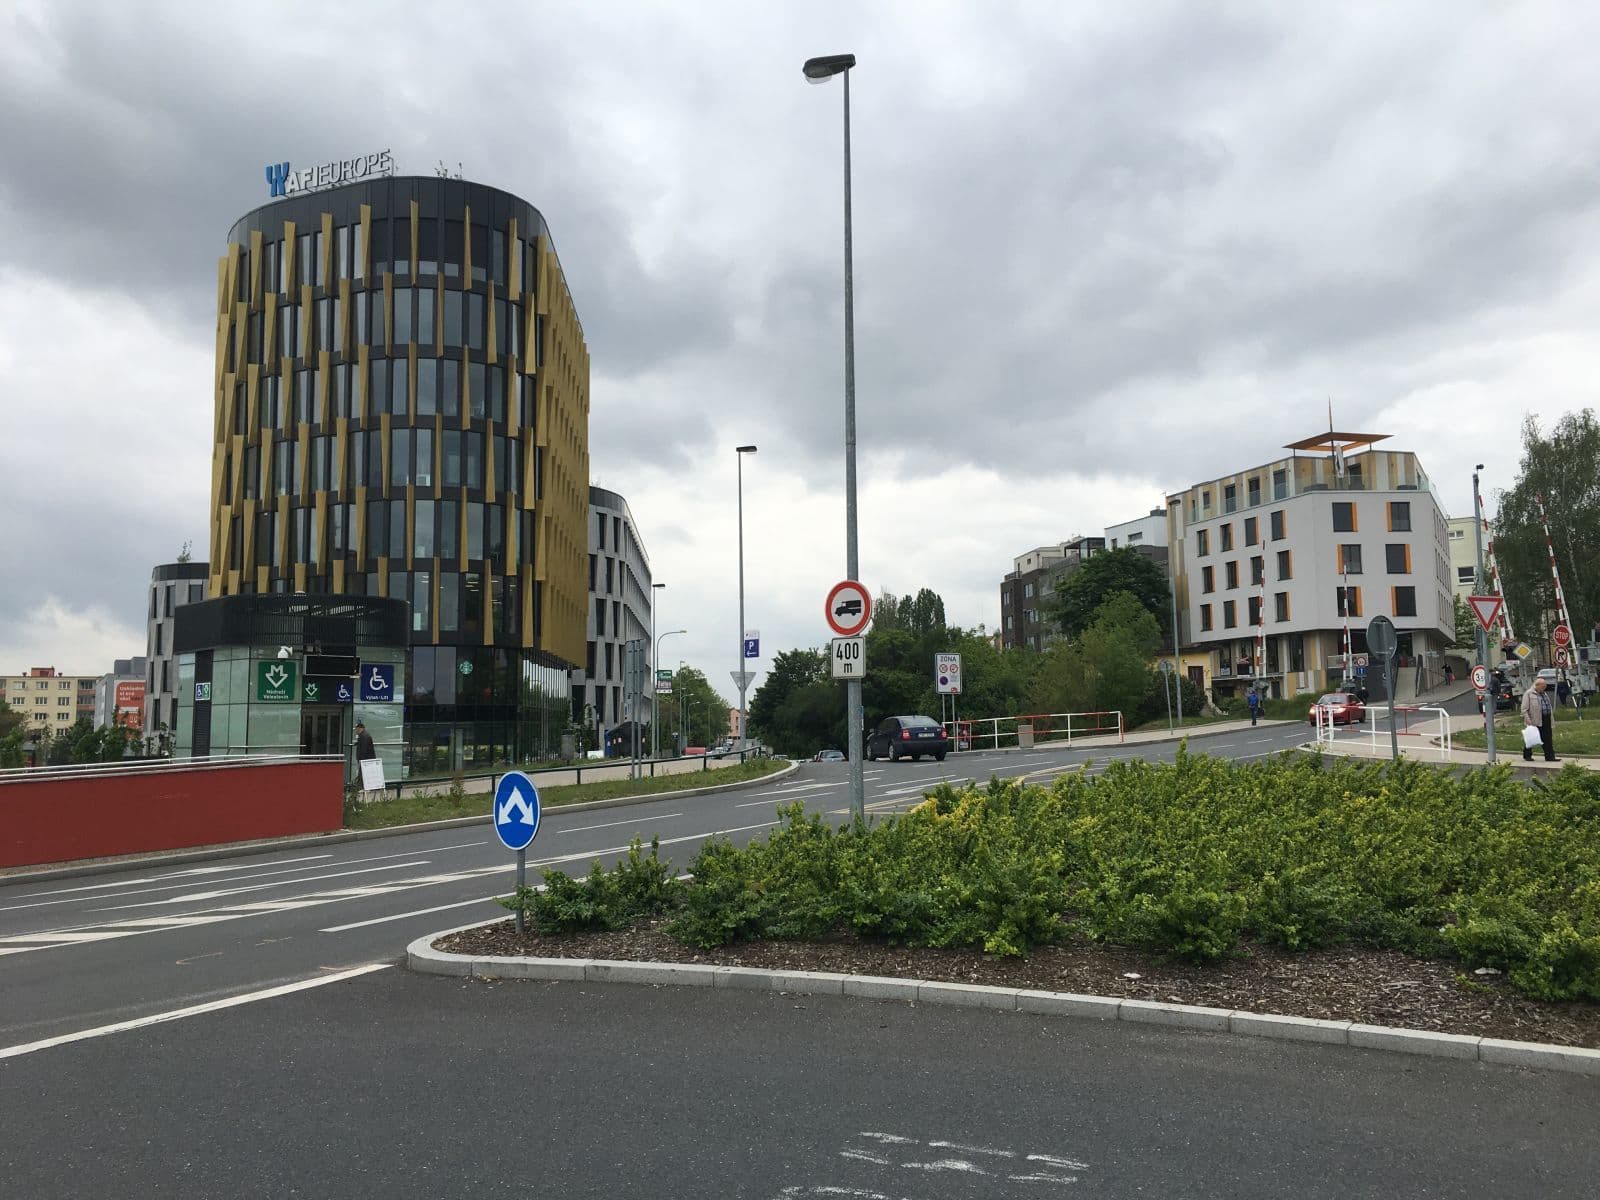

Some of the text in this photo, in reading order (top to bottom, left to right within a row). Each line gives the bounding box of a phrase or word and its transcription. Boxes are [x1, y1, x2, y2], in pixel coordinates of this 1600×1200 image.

[1555, 631, 1569, 640] STOP
[836, 642, 859, 660] 400
[843, 662, 853, 674] m
